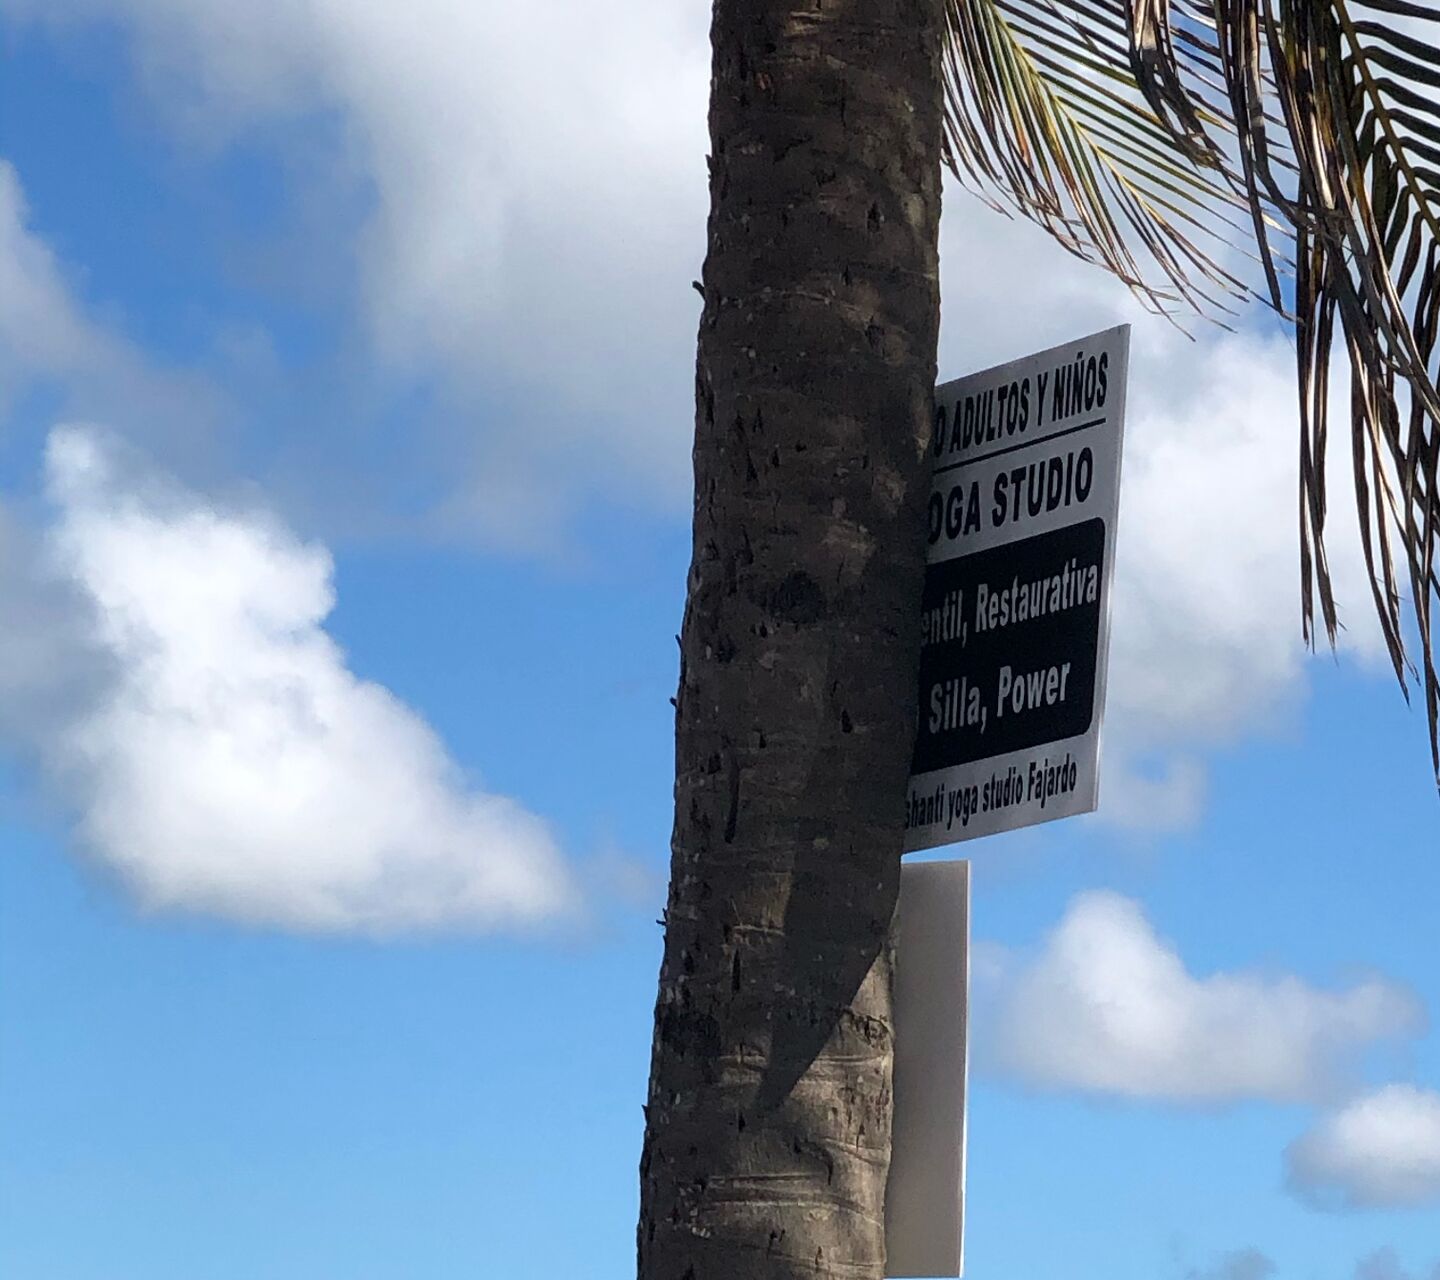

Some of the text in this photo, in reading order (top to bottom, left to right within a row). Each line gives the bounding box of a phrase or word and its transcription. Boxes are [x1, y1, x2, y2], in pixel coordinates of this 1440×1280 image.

[949, 378, 1030, 454] ADULTOS
[1037, 372, 1048, 426] Y
[1052, 351, 1108, 422] NIÑOS
[928, 447, 1093, 544] OGA STUDIO
[921, 558, 1098, 648] entil, Restaurativa
[929, 662, 1071, 734] Silla, Power
[947, 784, 978, 830] yoga
[982, 766, 1023, 812] studio
[1027, 753, 1077, 808] Fajardo
